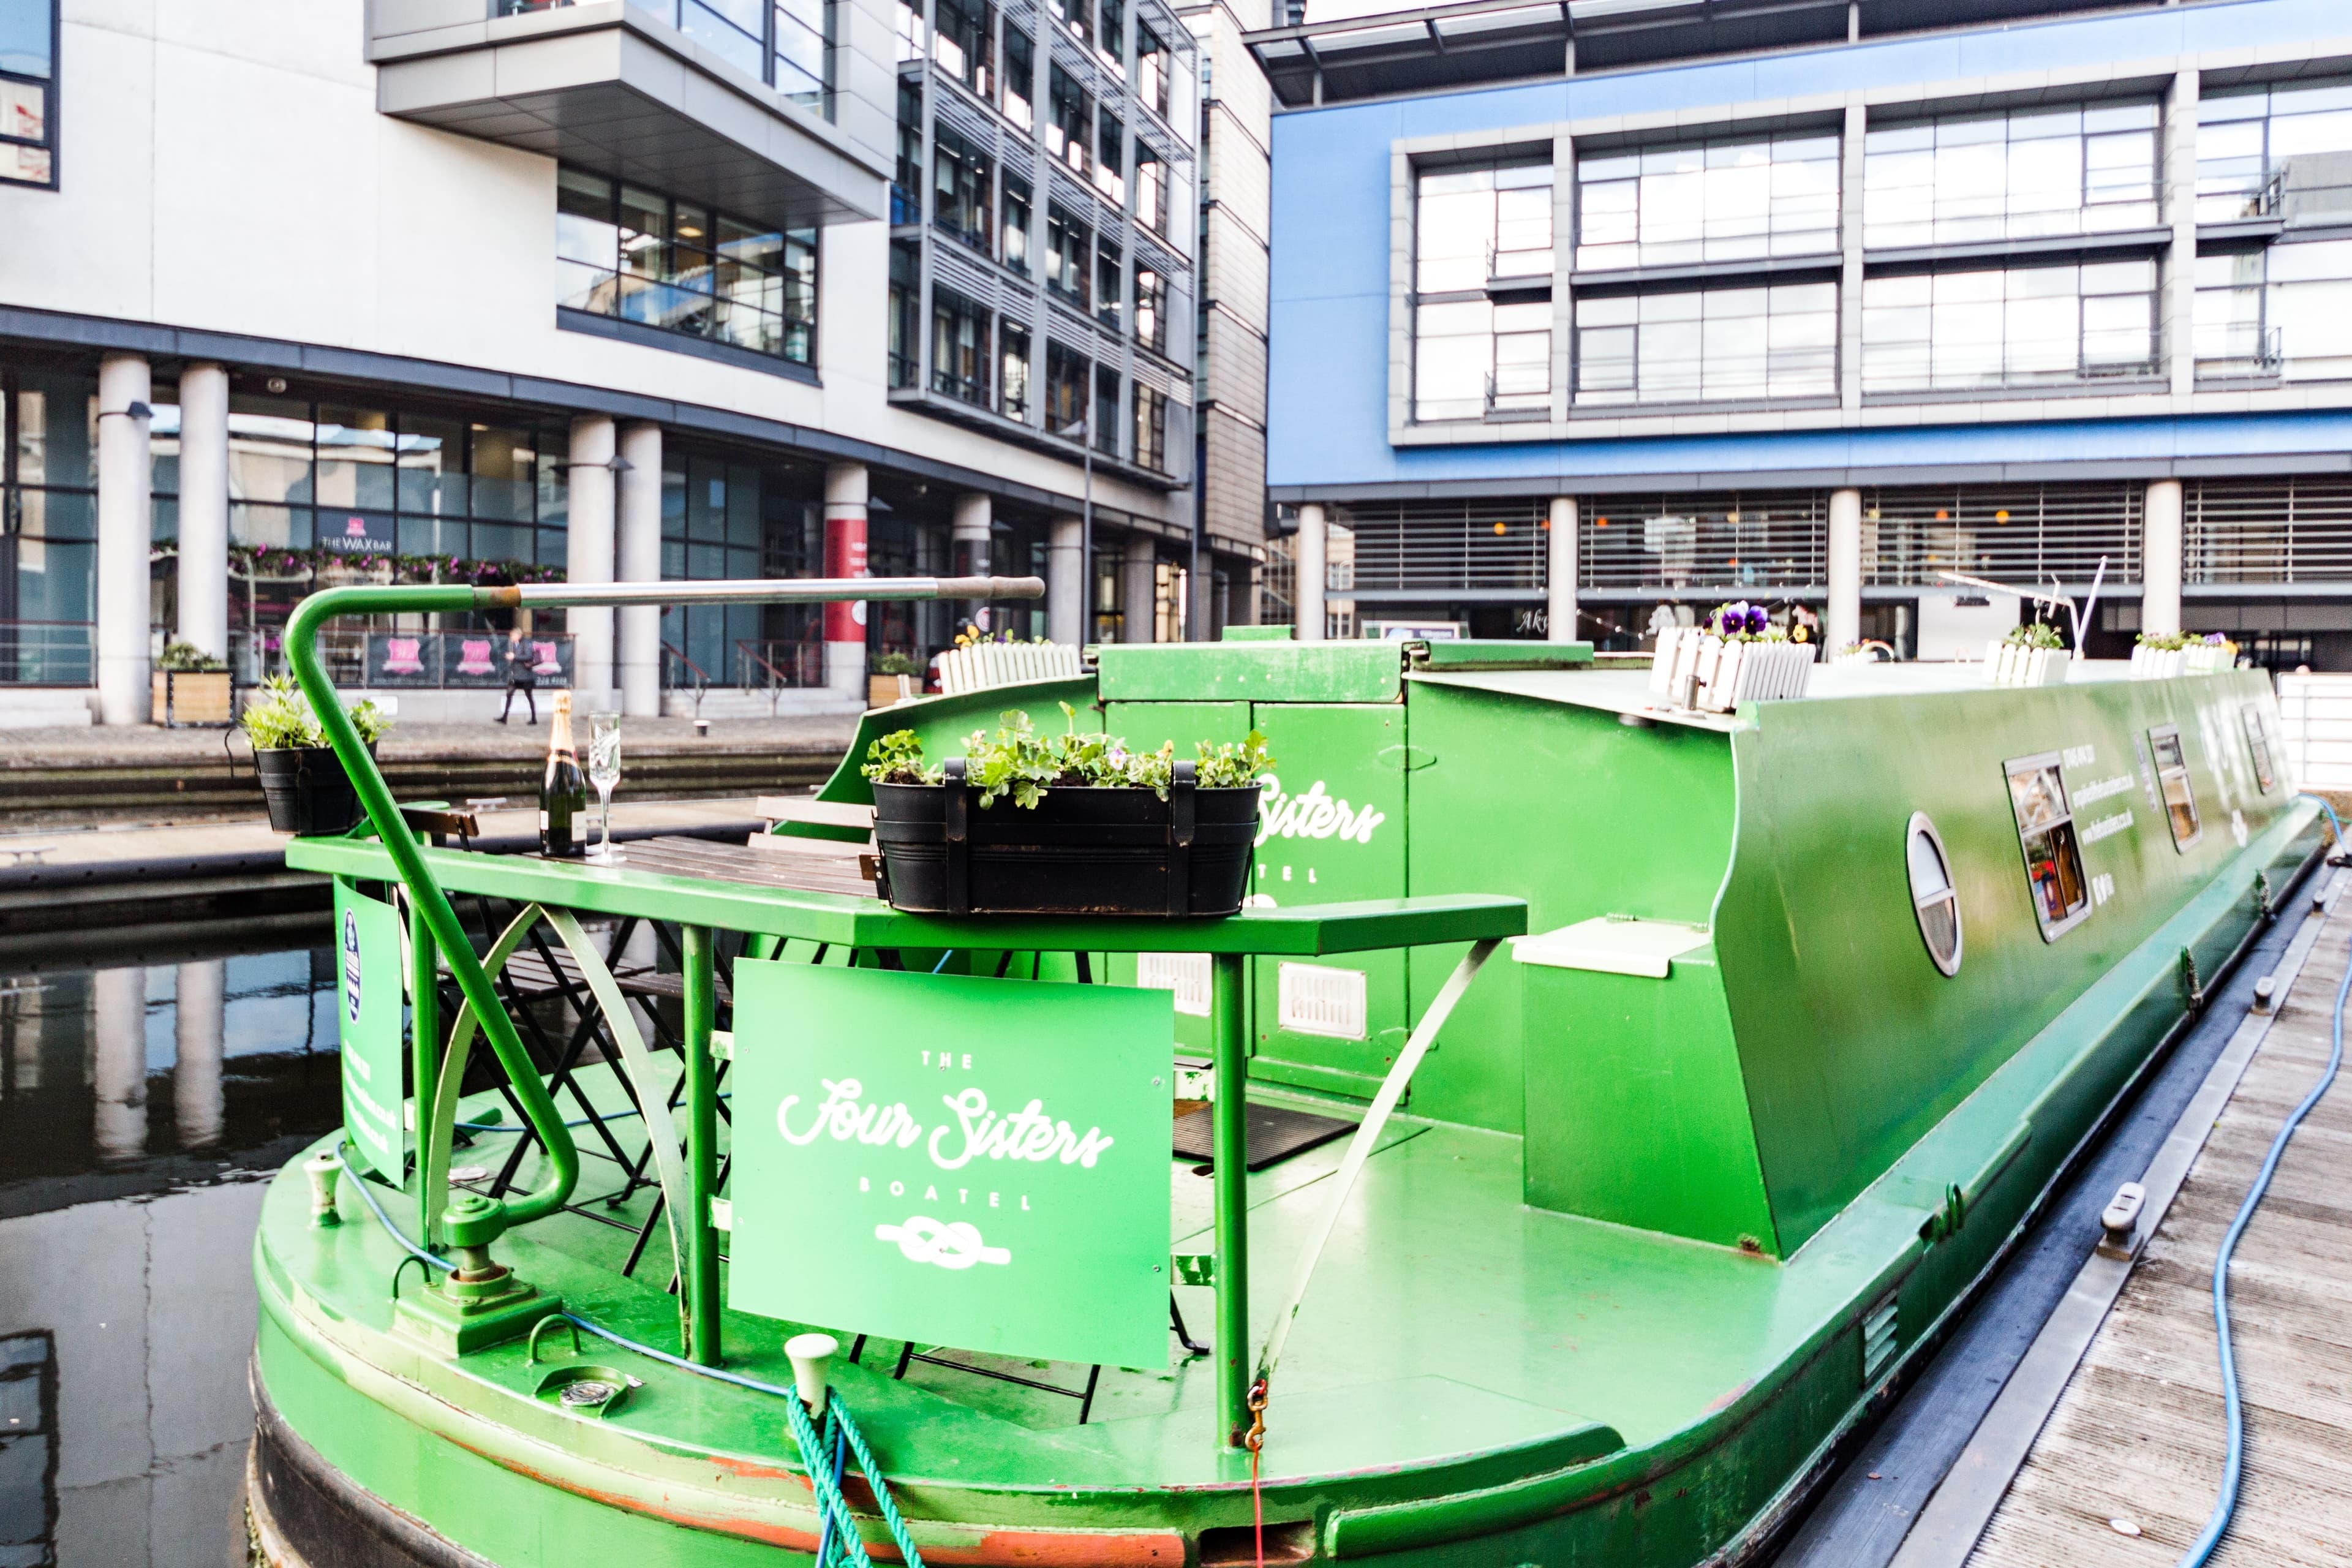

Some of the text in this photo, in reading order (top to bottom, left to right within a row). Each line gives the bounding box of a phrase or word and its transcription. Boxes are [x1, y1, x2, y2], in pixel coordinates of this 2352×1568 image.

[322, 536, 341, 549] THE
[1253, 772, 1385, 848] Sisters
[1257, 864, 1316, 884] TEL
[921, 1050, 972, 1069] THE
[777, 1077, 1114, 1170] Four Sisters
[859, 1176, 1030, 1211] BOATEL
